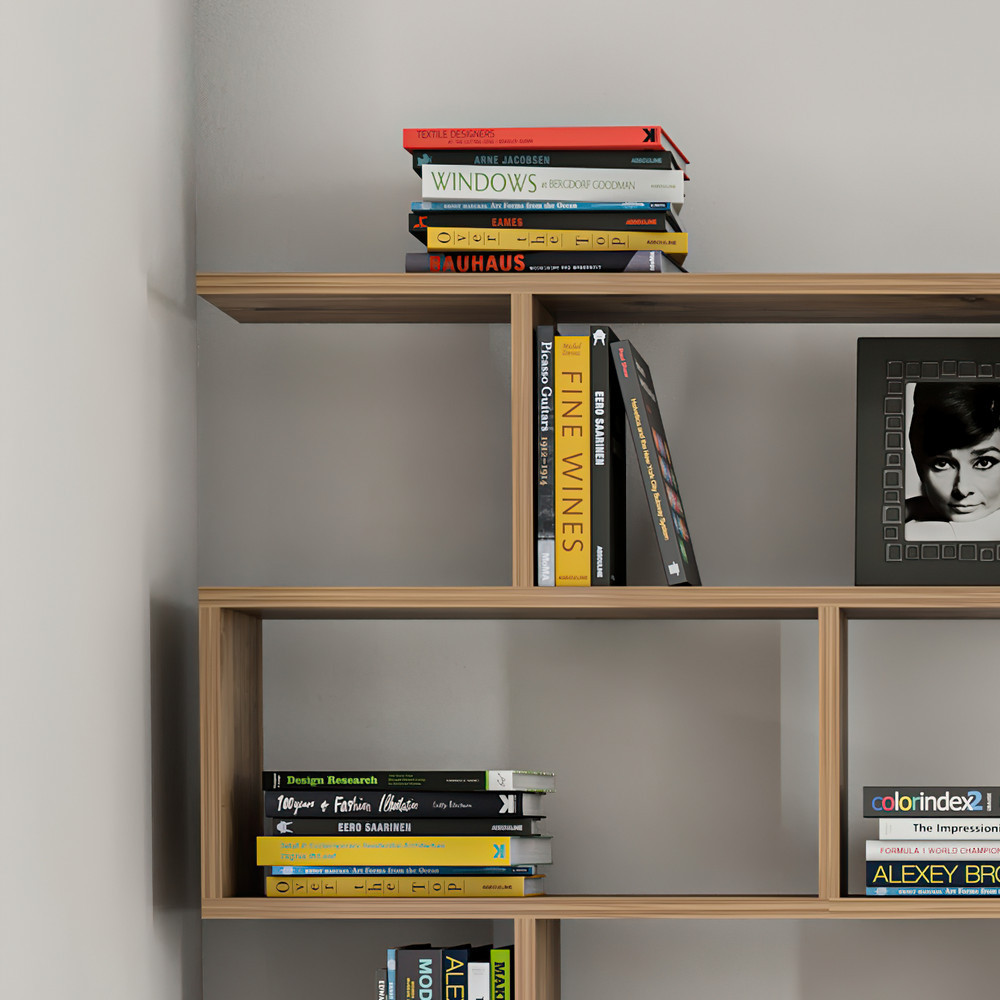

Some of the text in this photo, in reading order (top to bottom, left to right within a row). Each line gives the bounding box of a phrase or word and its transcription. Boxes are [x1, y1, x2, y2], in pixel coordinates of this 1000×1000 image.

[416, 129, 495, 139] TEXTILE DESIGNERS
[474, 154, 550, 165] ARNE JACOBSEN
[431, 171, 537, 193] WINDOWS
[548, 179, 591, 190] BERGDORF
[593, 179, 636, 190] GOODMAN
[491, 217, 523, 227] EAMES
[437, 231, 626, 246] Over the Top
[429, 254, 526, 272] BAUHAUS
[540, 341, 552, 384] Picasso
[540, 386, 552, 432] Guitars
[561, 371, 583, 437] FINE
[594, 391, 605, 466] EERO SAARINEN
[562, 453, 584, 552] WINES
[541, 552, 550, 581] MoMA
[287, 775, 324, 787] Design
[327, 775, 378, 785] Research
[334, 795, 371, 813] Fashion
[337, 822, 412, 832] EERO SAARINEN
[913, 823, 933, 833] The
[872, 864, 959, 884] ALEXEY
[275, 881, 462, 893] Over the Top
